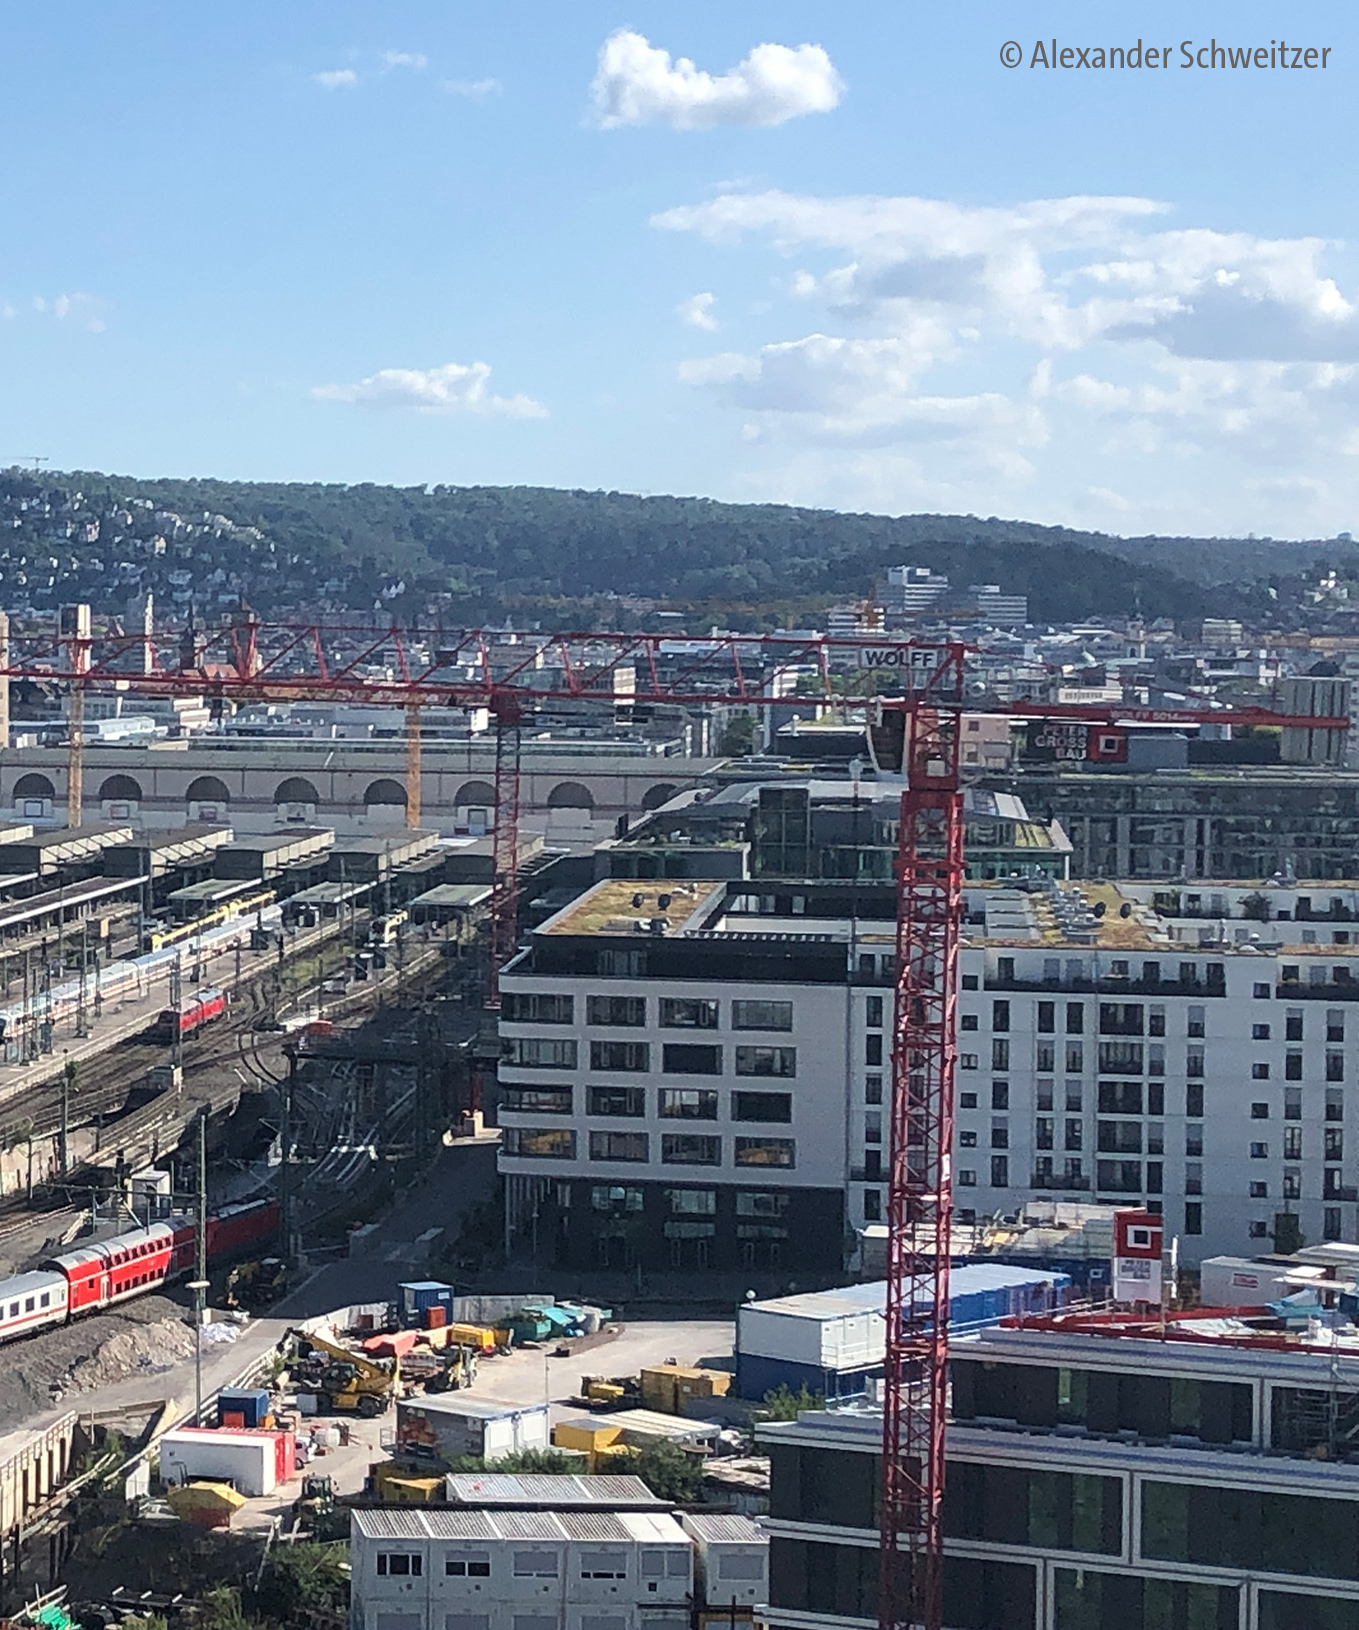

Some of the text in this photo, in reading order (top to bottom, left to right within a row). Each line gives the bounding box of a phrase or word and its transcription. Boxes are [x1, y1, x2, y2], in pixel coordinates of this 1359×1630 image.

[865, 650, 934, 667] WOLFF
[1043, 724, 1088, 737] PETER
[1034, 735, 1087, 749] GROSS
[1055, 747, 1087, 760] BAU
